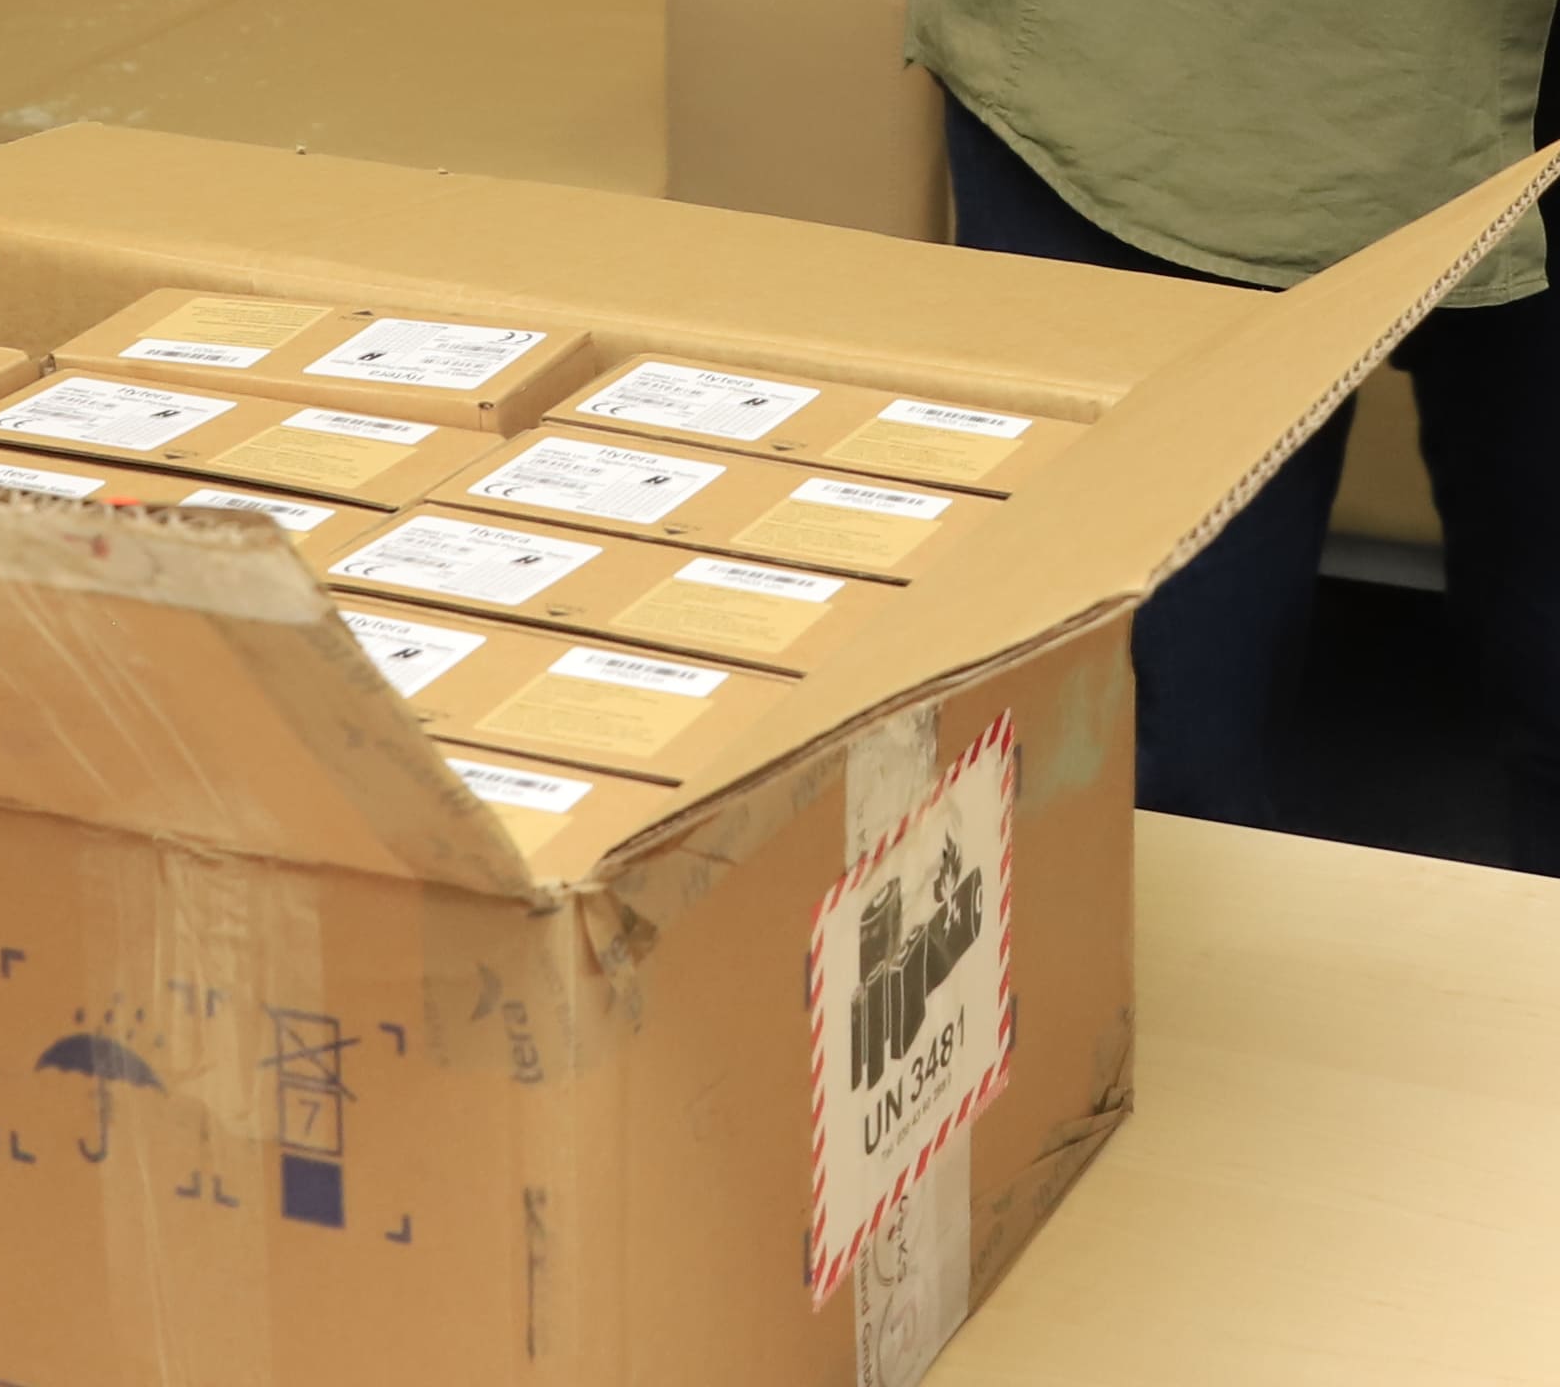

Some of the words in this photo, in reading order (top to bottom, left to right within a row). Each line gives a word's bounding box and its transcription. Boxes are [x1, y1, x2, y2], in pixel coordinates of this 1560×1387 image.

[696, 371, 755, 388] Hytera
[118, 386, 173, 402] Hytera
[598, 447, 658, 464] Hytera
[469, 526, 531, 545] Hytera
[863, 1074, 905, 1156] UN
[909, 1003, 966, 1104] 3481
